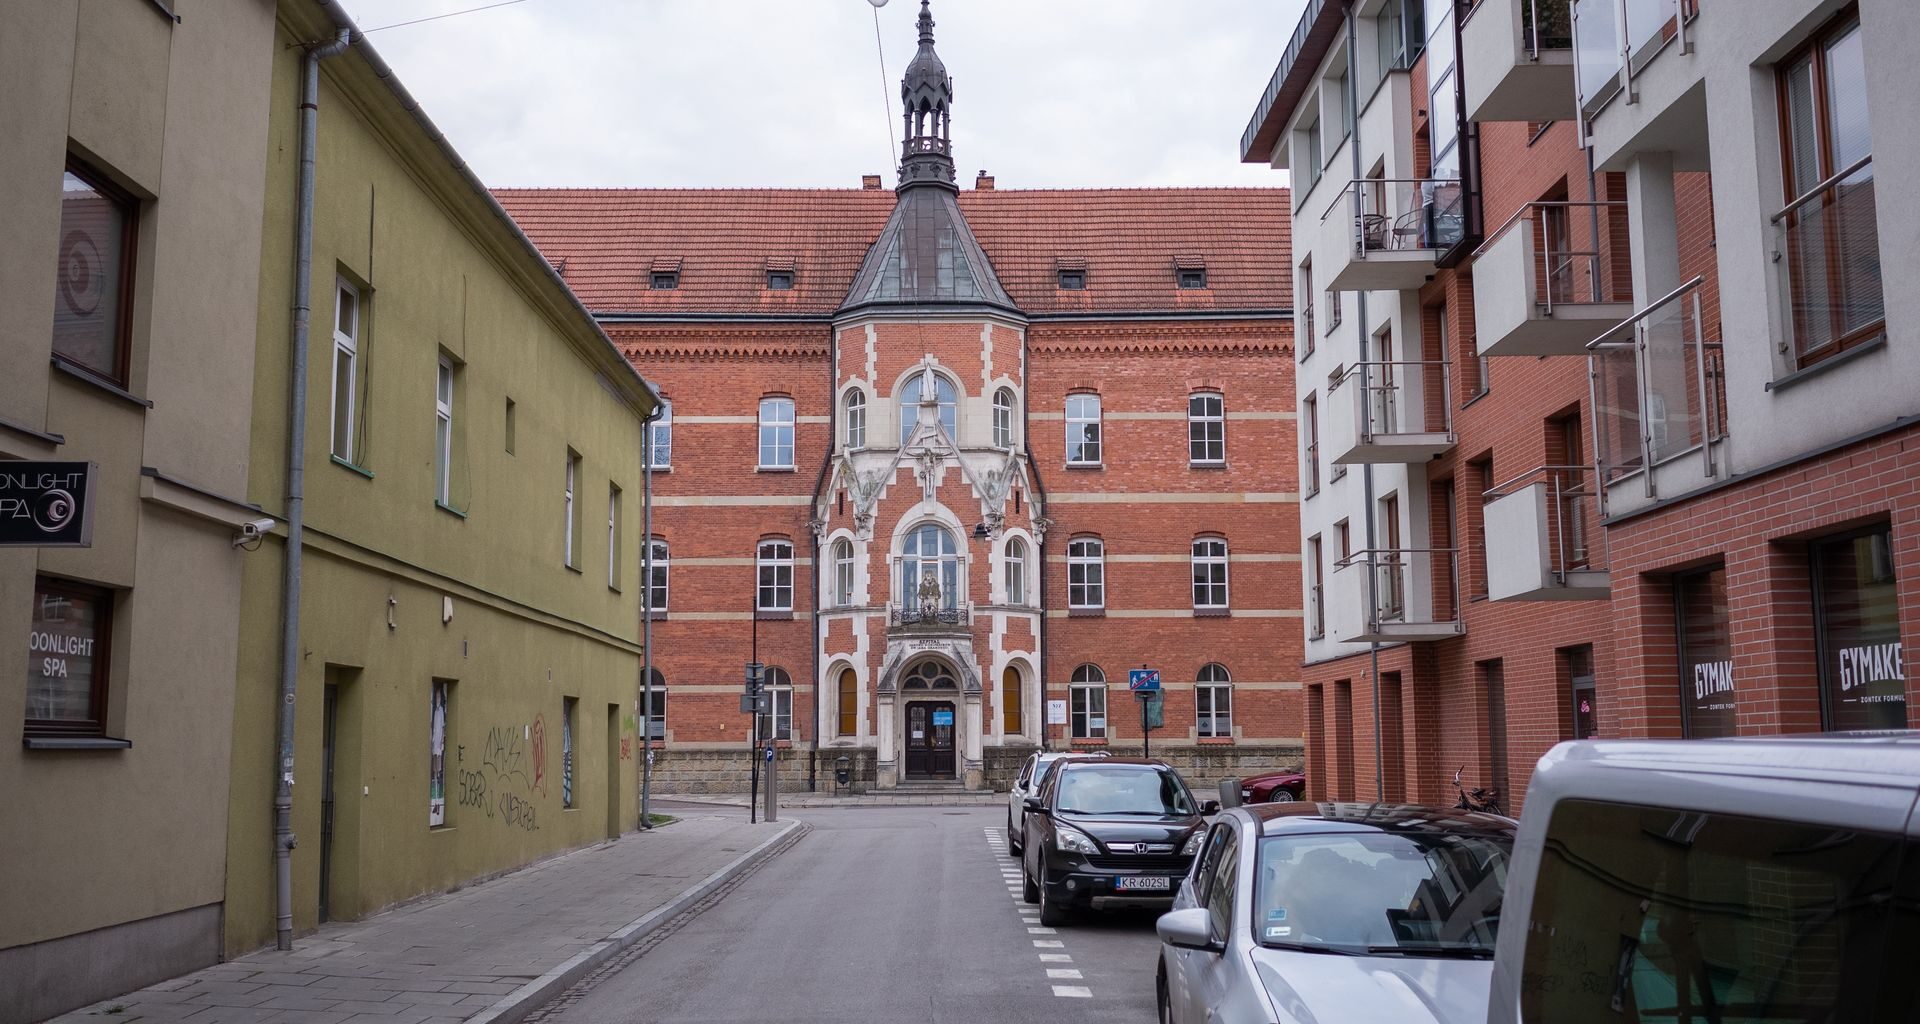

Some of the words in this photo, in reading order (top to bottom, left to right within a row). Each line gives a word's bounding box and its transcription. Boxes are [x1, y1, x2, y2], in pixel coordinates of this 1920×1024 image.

[30, 631, 94, 657] OONLIGHT
[43, 657, 68, 678] SPA
[1839, 642, 1905, 691] GYMAKE
[1695, 660, 1734, 700] GYMAK
[1860, 695, 1882, 703] ZONTEK
[766, 750, 773, 759] P
[1122, 877, 1137, 888] KR
[1139, 877, 1169, 888] 602SL
